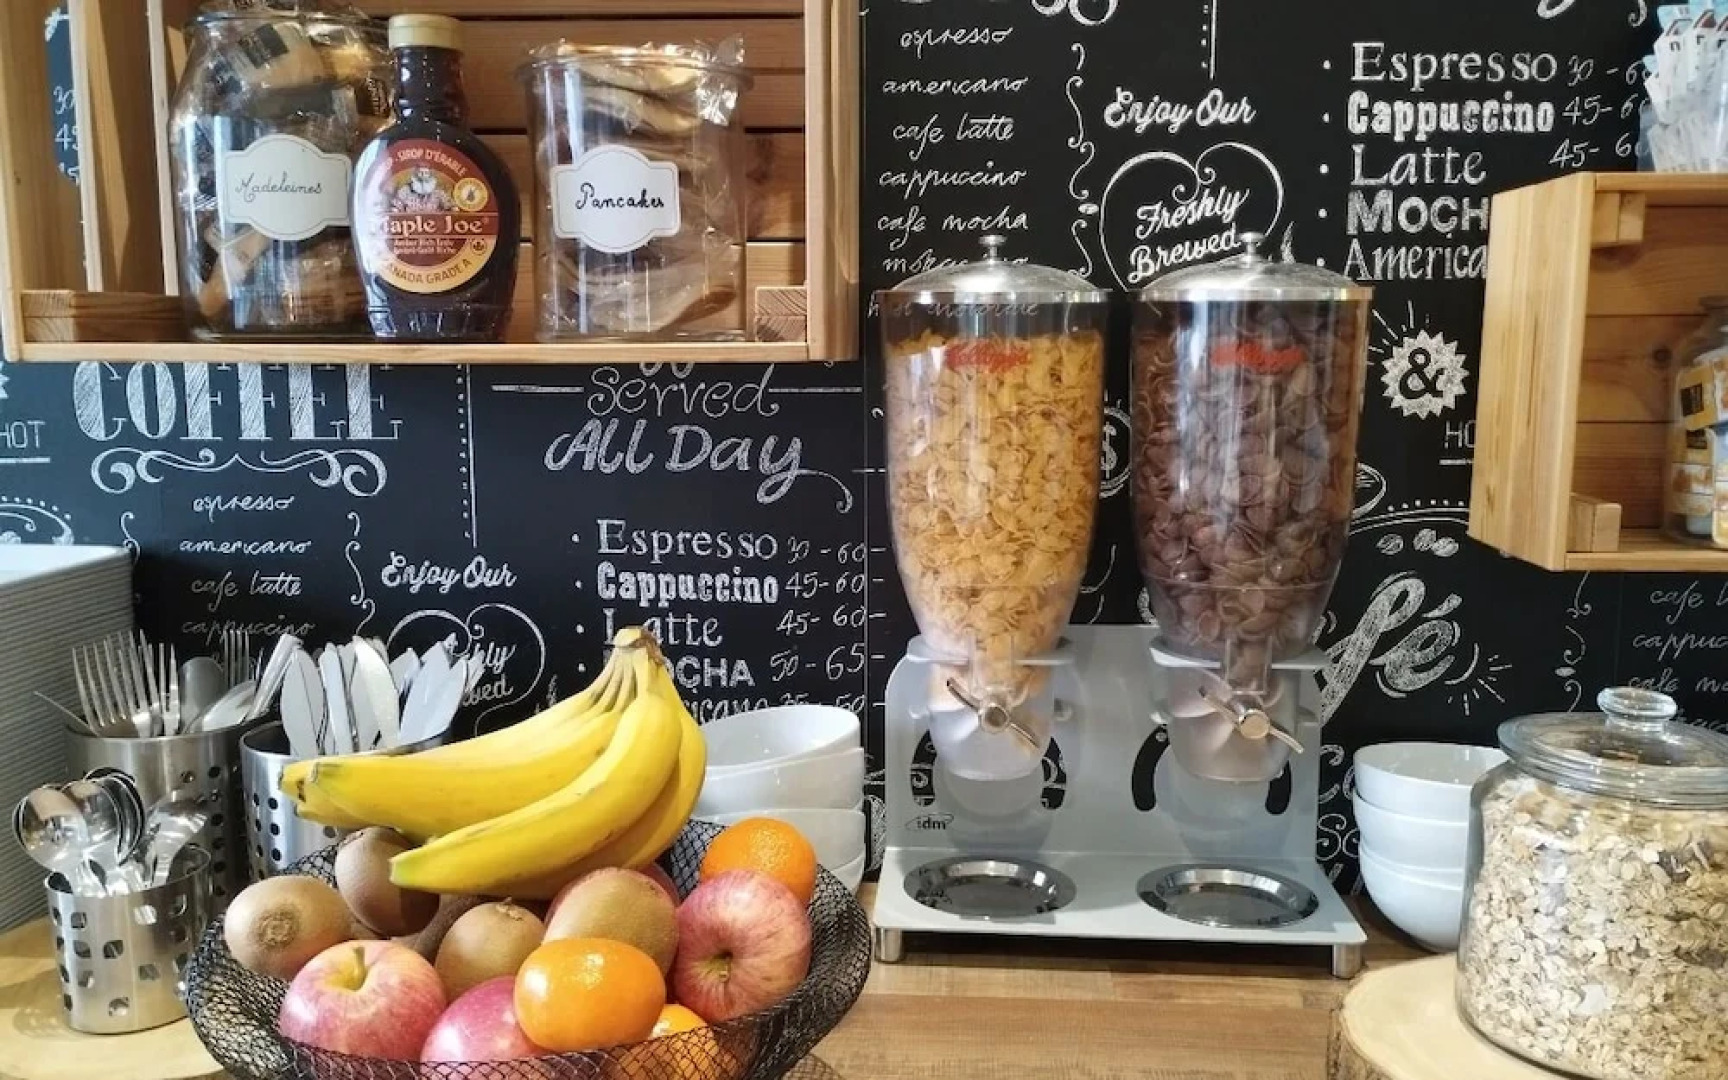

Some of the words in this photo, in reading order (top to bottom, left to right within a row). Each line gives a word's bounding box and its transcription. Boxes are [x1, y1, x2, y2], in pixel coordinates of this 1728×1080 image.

[900, 26, 1013, 59] espresso
[882, 76, 1029, 96] americano
[1350, 42, 1557, 92] Espresso
[1104, 86, 1194, 133] Enjoy
[1195, 88, 1256, 126] Our
[1347, 90, 1554, 142] Cappuccino
[893, 113, 944, 160] cafe
[956, 114, 1014, 142] latte
[879, 160, 1026, 199] cappuccino
[1350, 143, 1486, 186] Latte
[235, 172, 323, 203] Madeleines
[575, 182, 665, 210] Pancakes
[444, 215, 483, 234] Joe
[877, 205, 927, 251] cafe
[942, 205, 1029, 232] mocha
[1135, 184, 1250, 240] Freshly
[1346, 190, 1489, 238] MOCH
[1127, 222, 1243, 284] Brewed
[1343, 238, 1487, 281] America
[73, 361, 402, 441] COFFEE
[587, 364, 779, 418] Served
[1444, 421, 1476, 449] HO
[543, 418, 655, 475] All
[664, 424, 853, 514] Day
[193, 495, 296, 523] espresso
[179, 539, 312, 555] americano
[597, 519, 778, 563] Espresso
[191, 571, 239, 612] cafe
[249, 571, 302, 597] latte
[381, 551, 461, 593] Enjoy
[462, 555, 517, 589] Our
[597, 561, 779, 608] Cappuccino
[1650, 579, 1705, 625] cafe
[1632, 632, 1728, 662] cappuc
[667, 654, 756, 692] CHA
